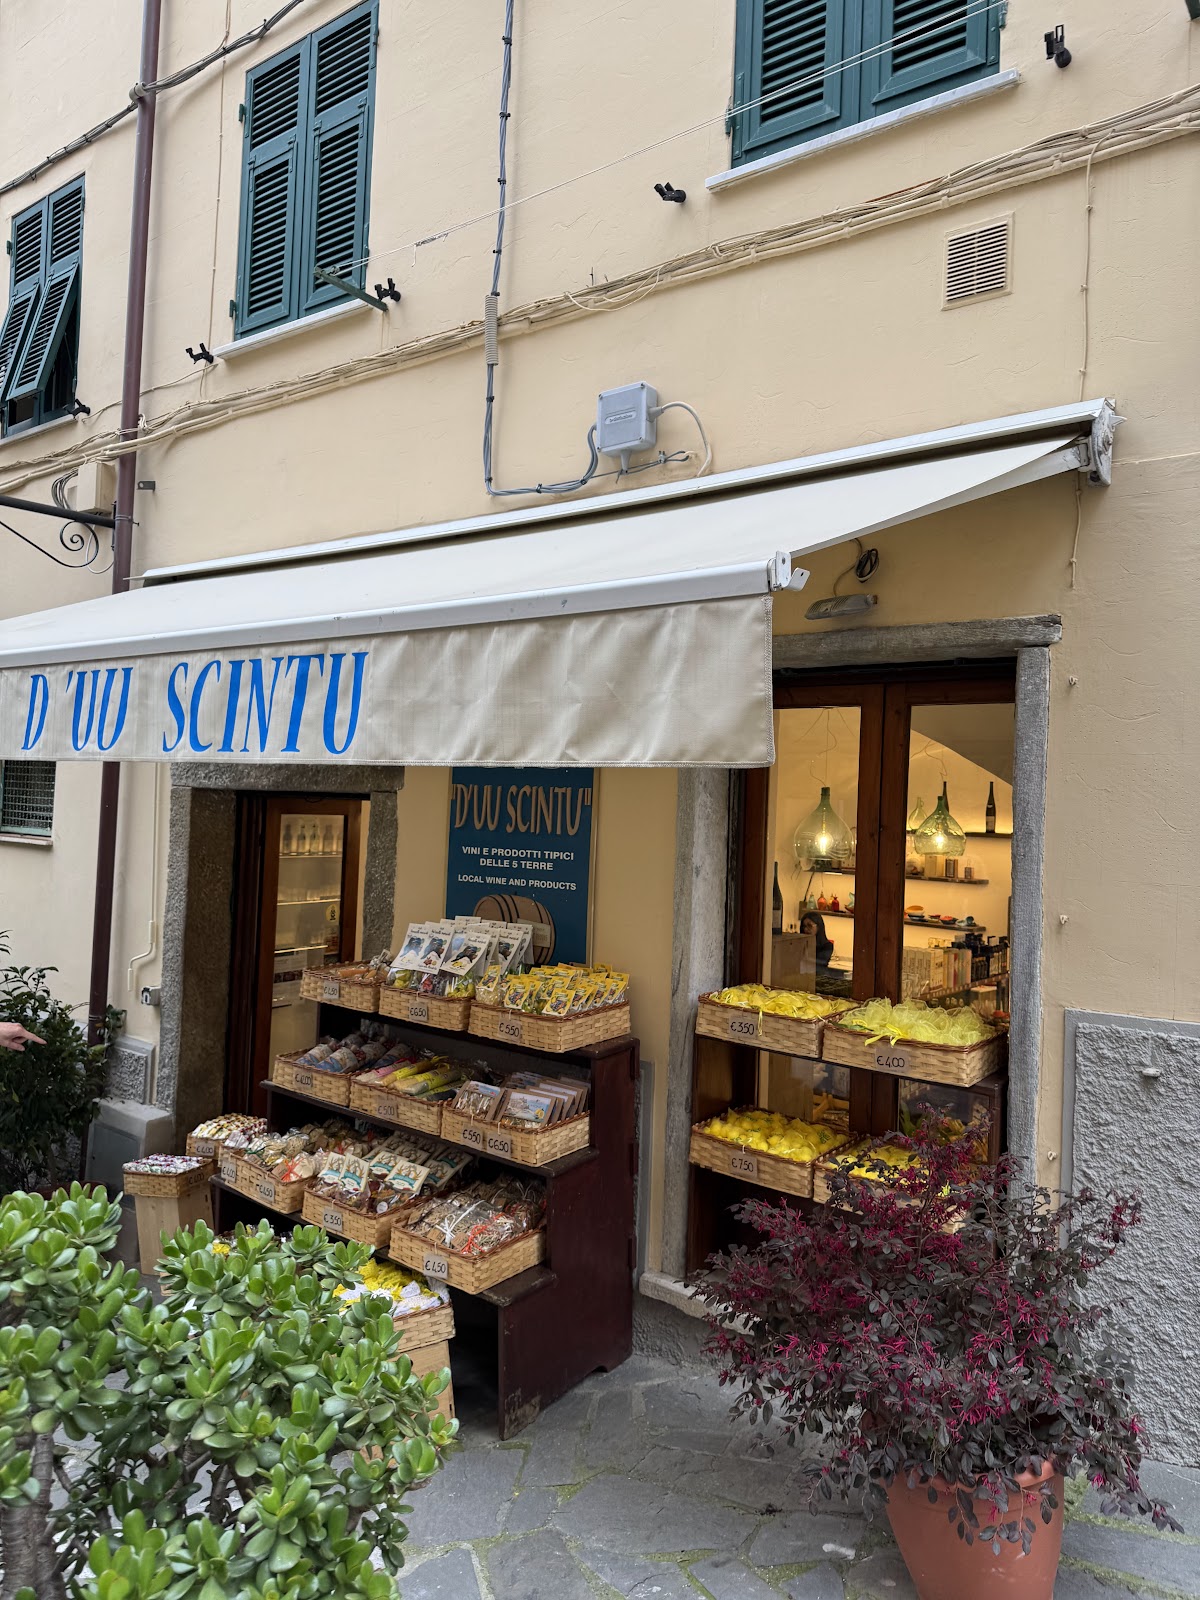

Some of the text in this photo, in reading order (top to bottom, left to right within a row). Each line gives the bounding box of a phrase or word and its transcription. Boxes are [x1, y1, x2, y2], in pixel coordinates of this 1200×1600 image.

[163, 651, 369, 755] SCINTU
[462, 846, 574, 861] VINI E PRODOTTI TIPICI
[480, 858, 509, 868] DELLE
[520, 861, 553, 870] TERRE
[458, 874, 577, 891] LOCAL WINE AND PRODUCTS
